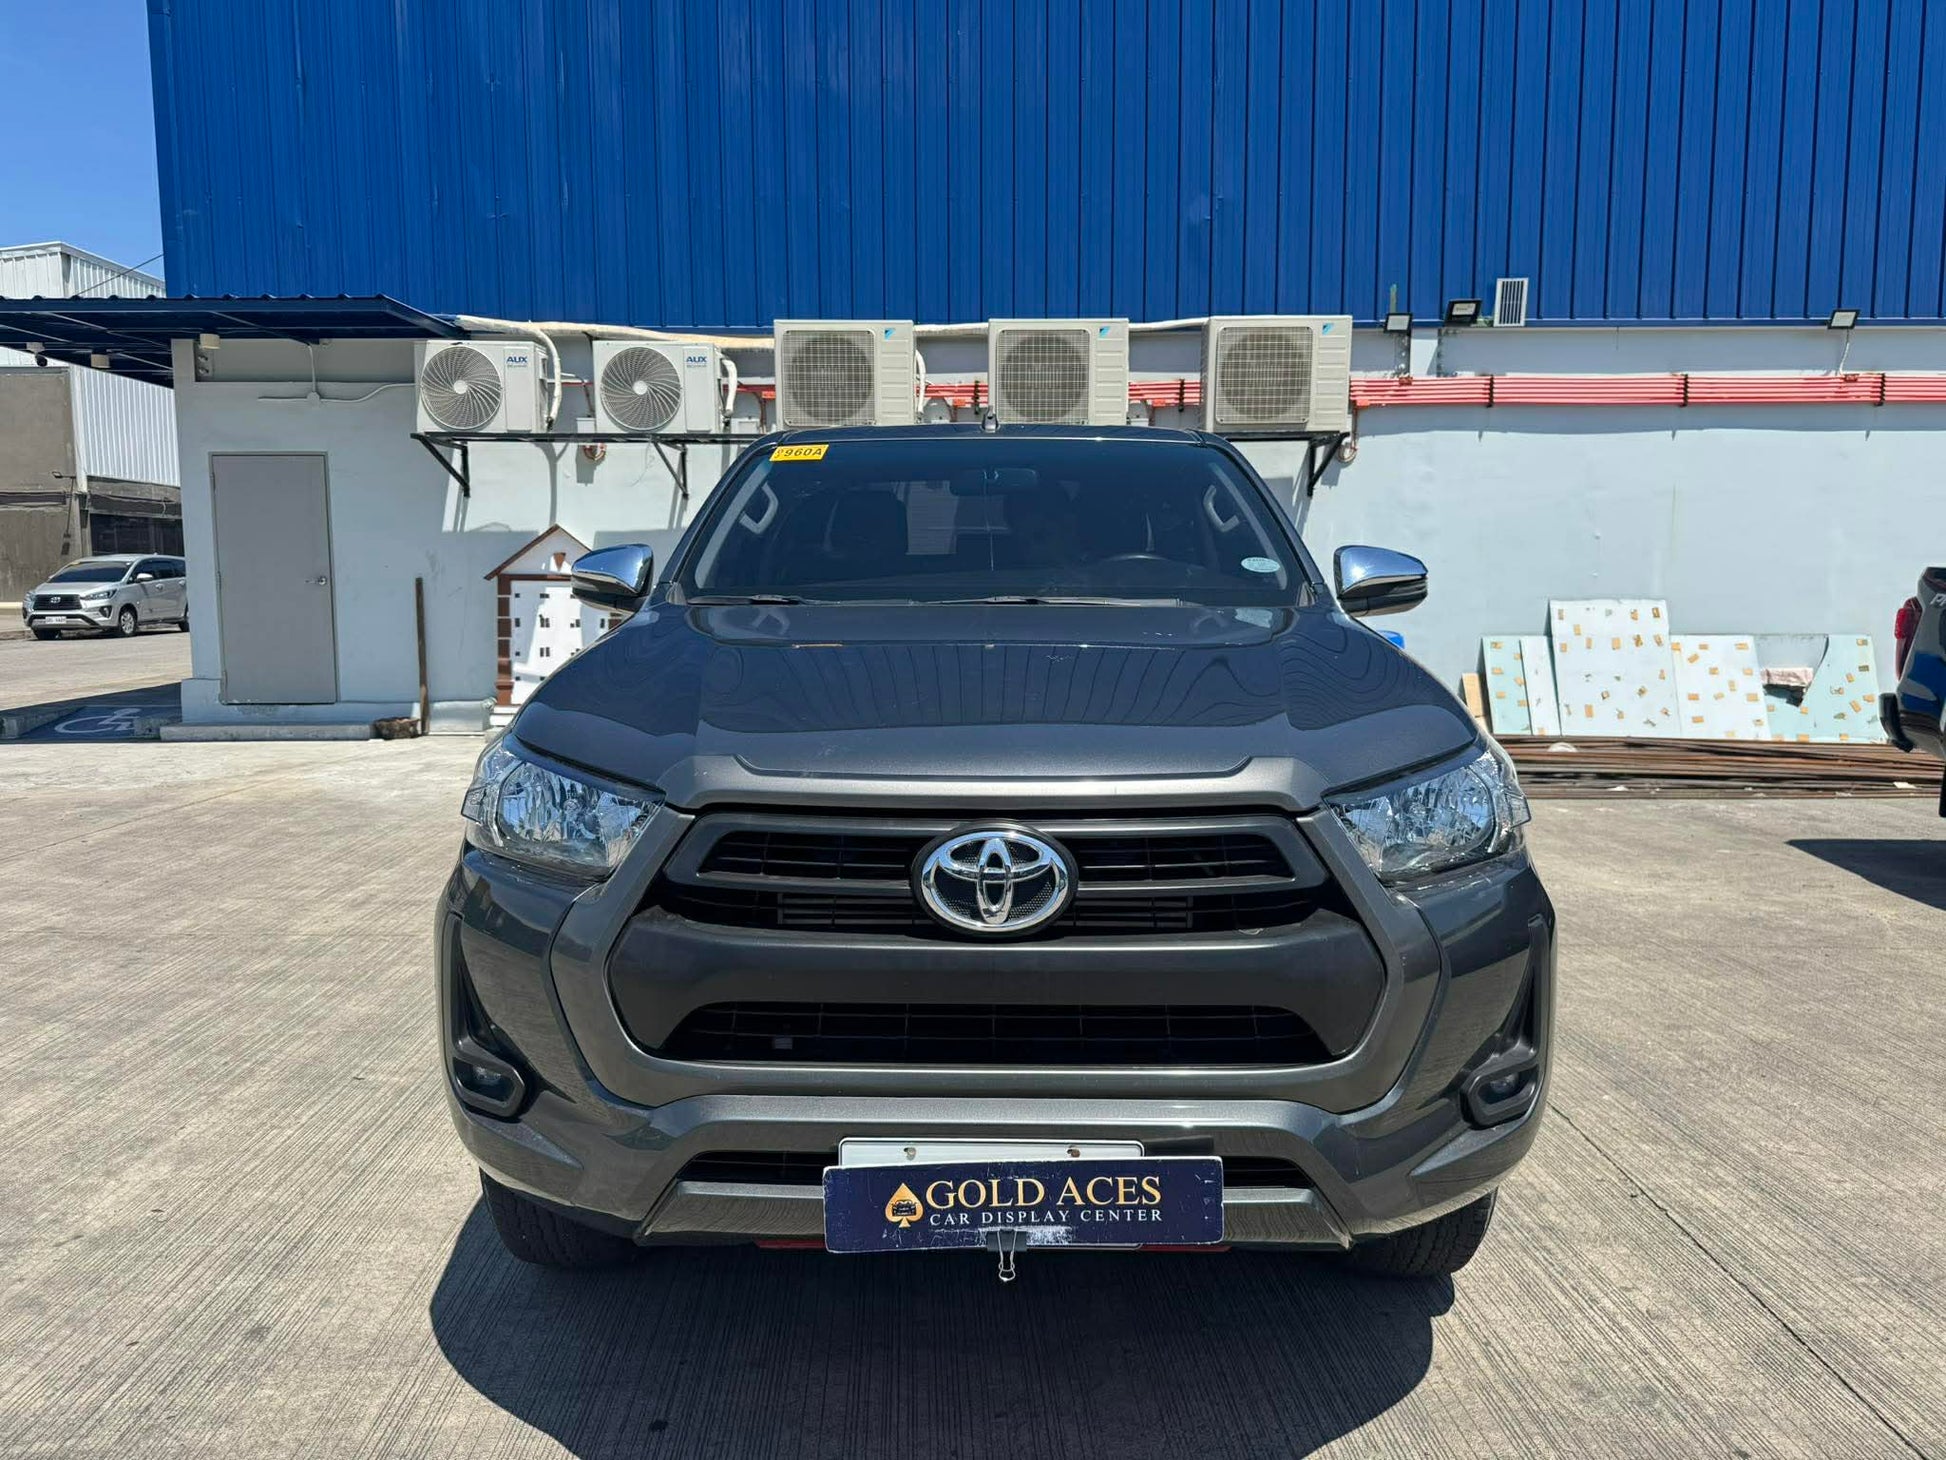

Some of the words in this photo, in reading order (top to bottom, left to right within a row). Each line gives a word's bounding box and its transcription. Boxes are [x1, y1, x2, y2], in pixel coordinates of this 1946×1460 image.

[925, 1176, 1045, 1210] GOLD
[1056, 1175, 1161, 1206] ACES
[929, 1212, 971, 1226] CAR
[981, 1209, 1070, 1224] DISPLAY
[1080, 1208, 1162, 1222] CENTER
